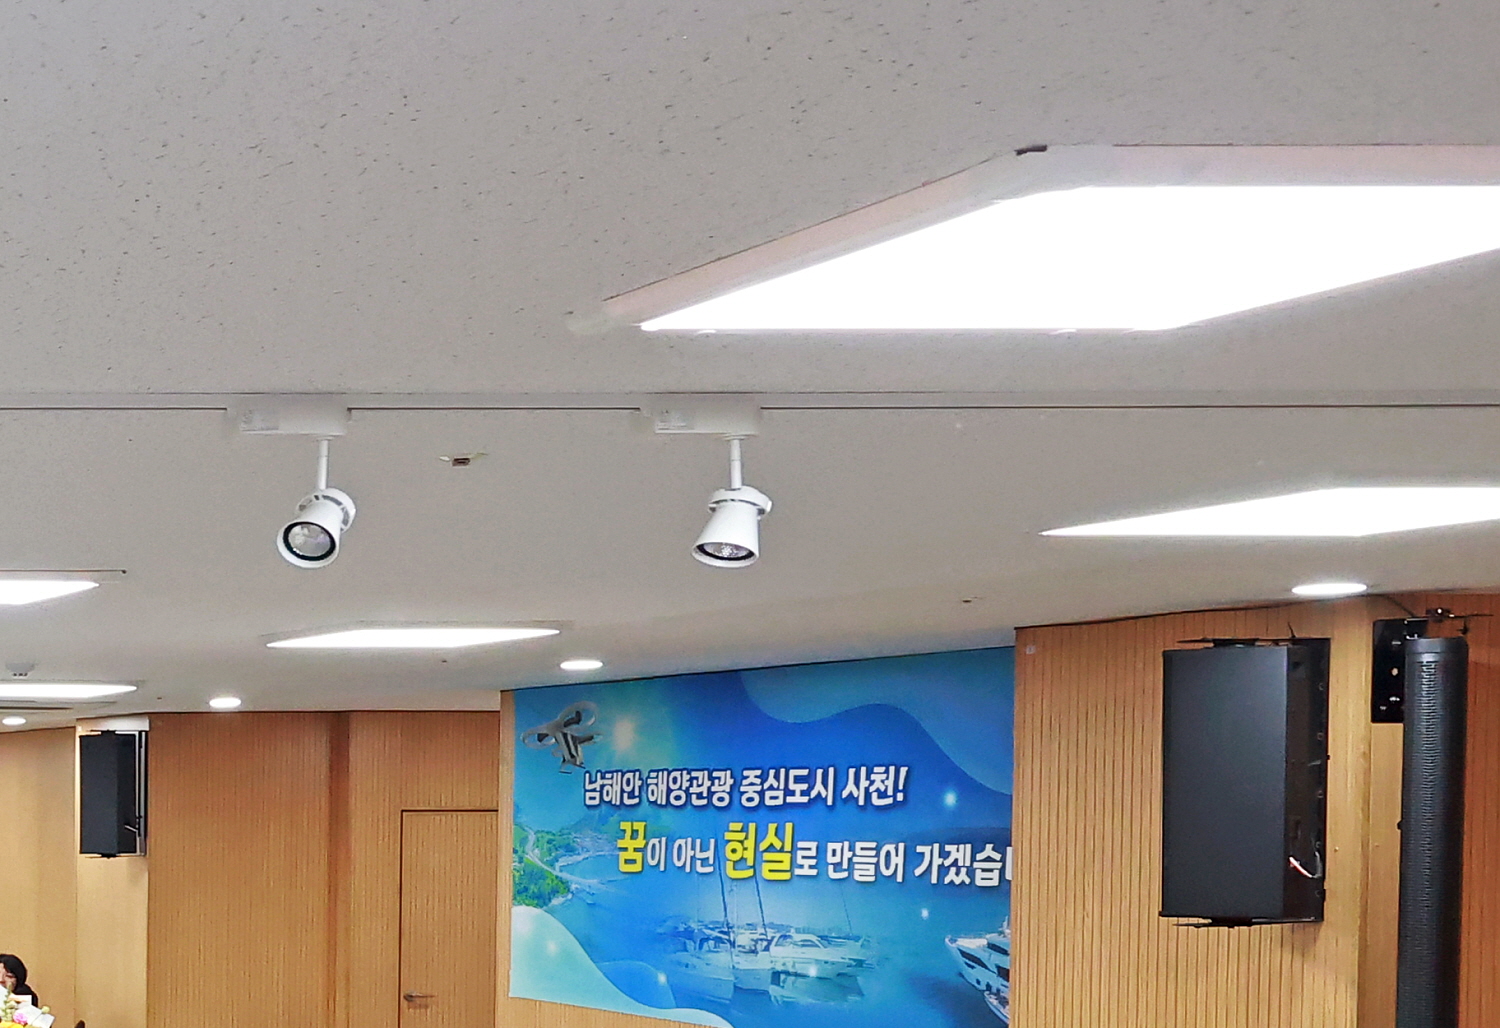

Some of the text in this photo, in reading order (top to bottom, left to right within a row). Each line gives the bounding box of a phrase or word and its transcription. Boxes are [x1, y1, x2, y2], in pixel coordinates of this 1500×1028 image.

[583, 766, 909, 807] 남해안 해양관광 중심도시 사천!
[616, 820, 666, 874] 꿈이
[672, 836, 716, 874] 아닌
[723, 821, 817, 881] 현실로
[826, 841, 904, 883] 만들어
